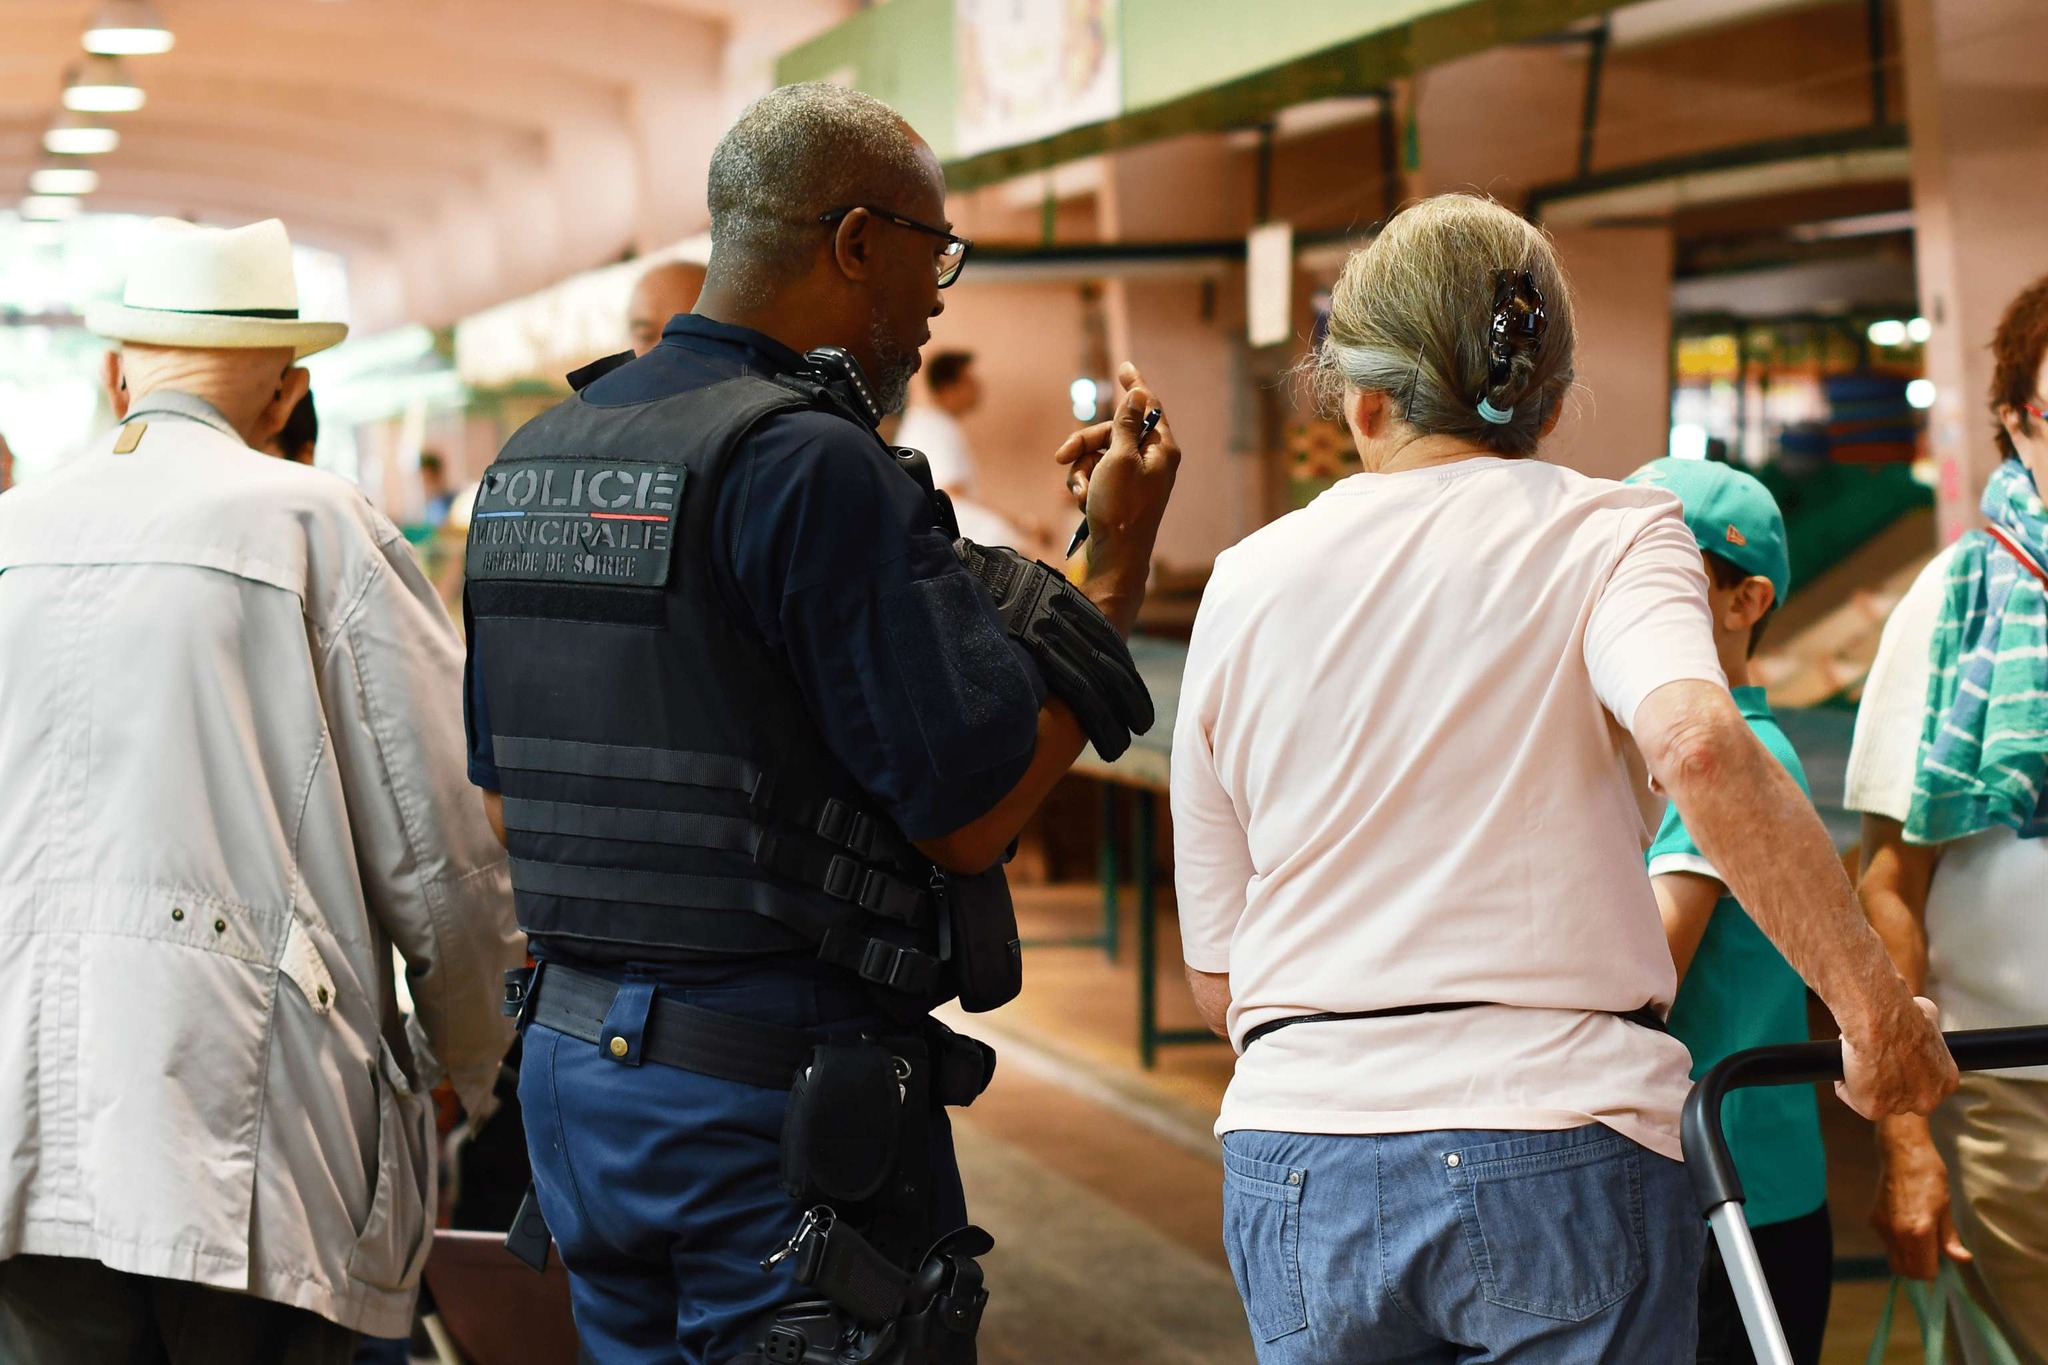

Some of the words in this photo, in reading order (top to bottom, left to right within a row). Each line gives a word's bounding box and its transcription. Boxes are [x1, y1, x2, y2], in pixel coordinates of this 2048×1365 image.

[478, 469, 678, 510] POLICE
[472, 520, 668, 550] MUNICIPALE
[483, 551, 539, 572] BRIGADE
[546, 552, 566, 573] DE
